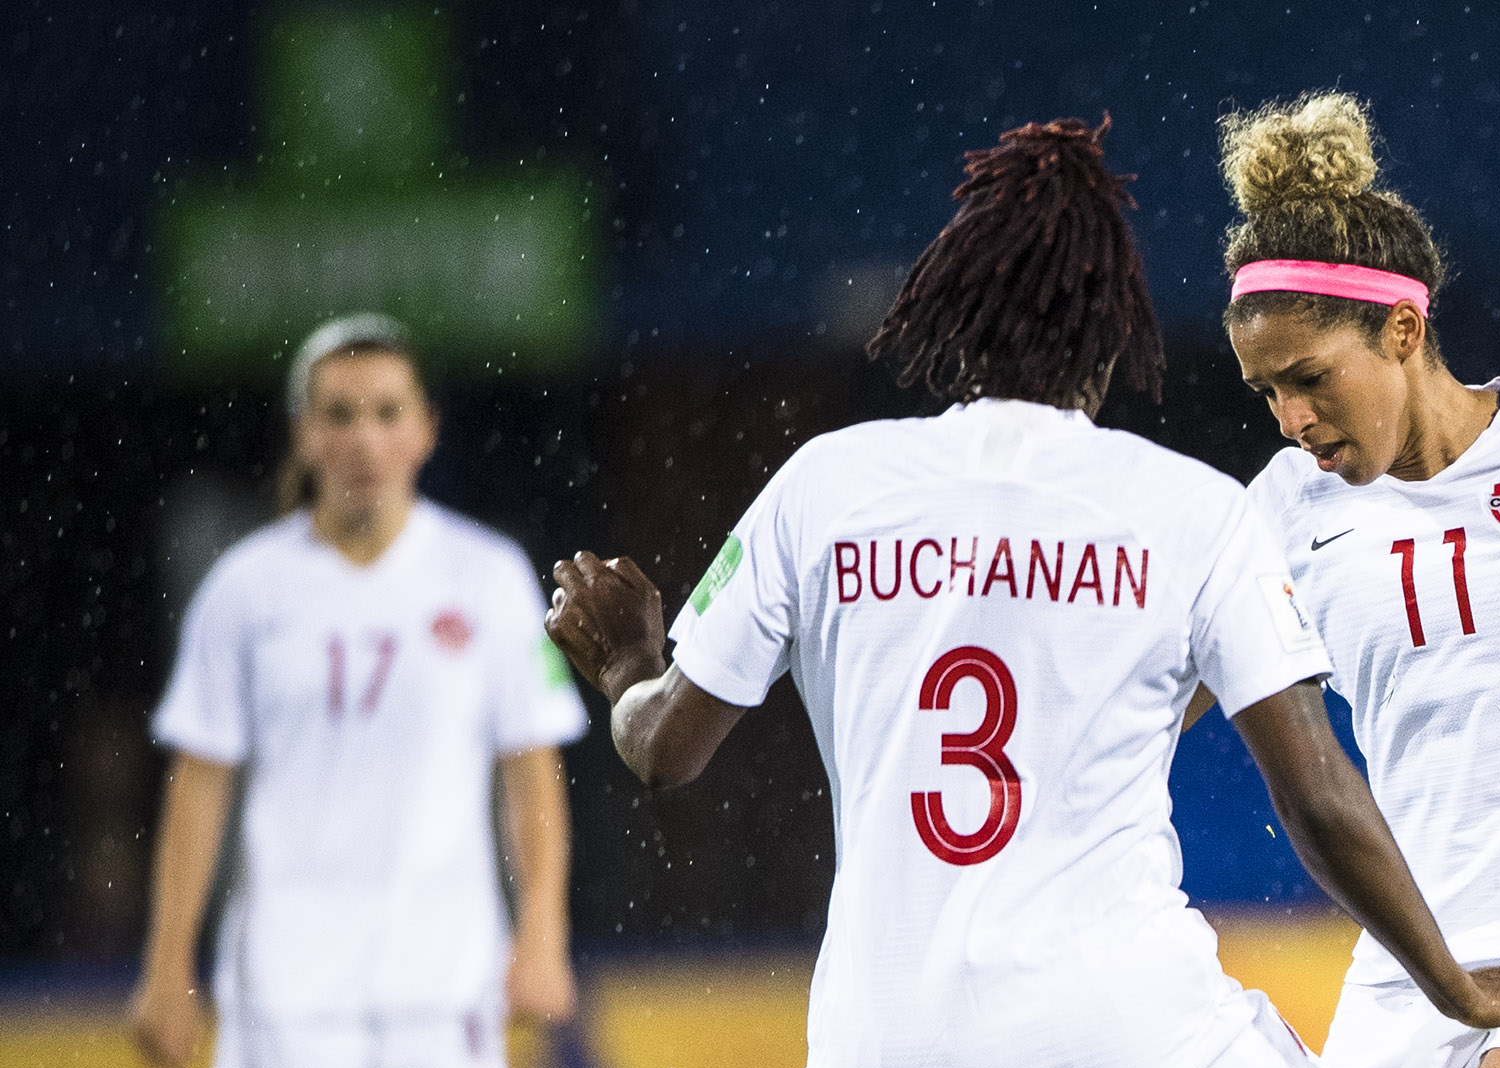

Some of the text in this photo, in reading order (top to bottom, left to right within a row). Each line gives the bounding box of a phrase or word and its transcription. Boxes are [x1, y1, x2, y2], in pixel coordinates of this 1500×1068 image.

[834, 536, 1149, 609] BUCHANAN
[1390, 527, 1476, 647] 11
[325, 632, 397, 720] 17
[910, 645, 1022, 866] 3
